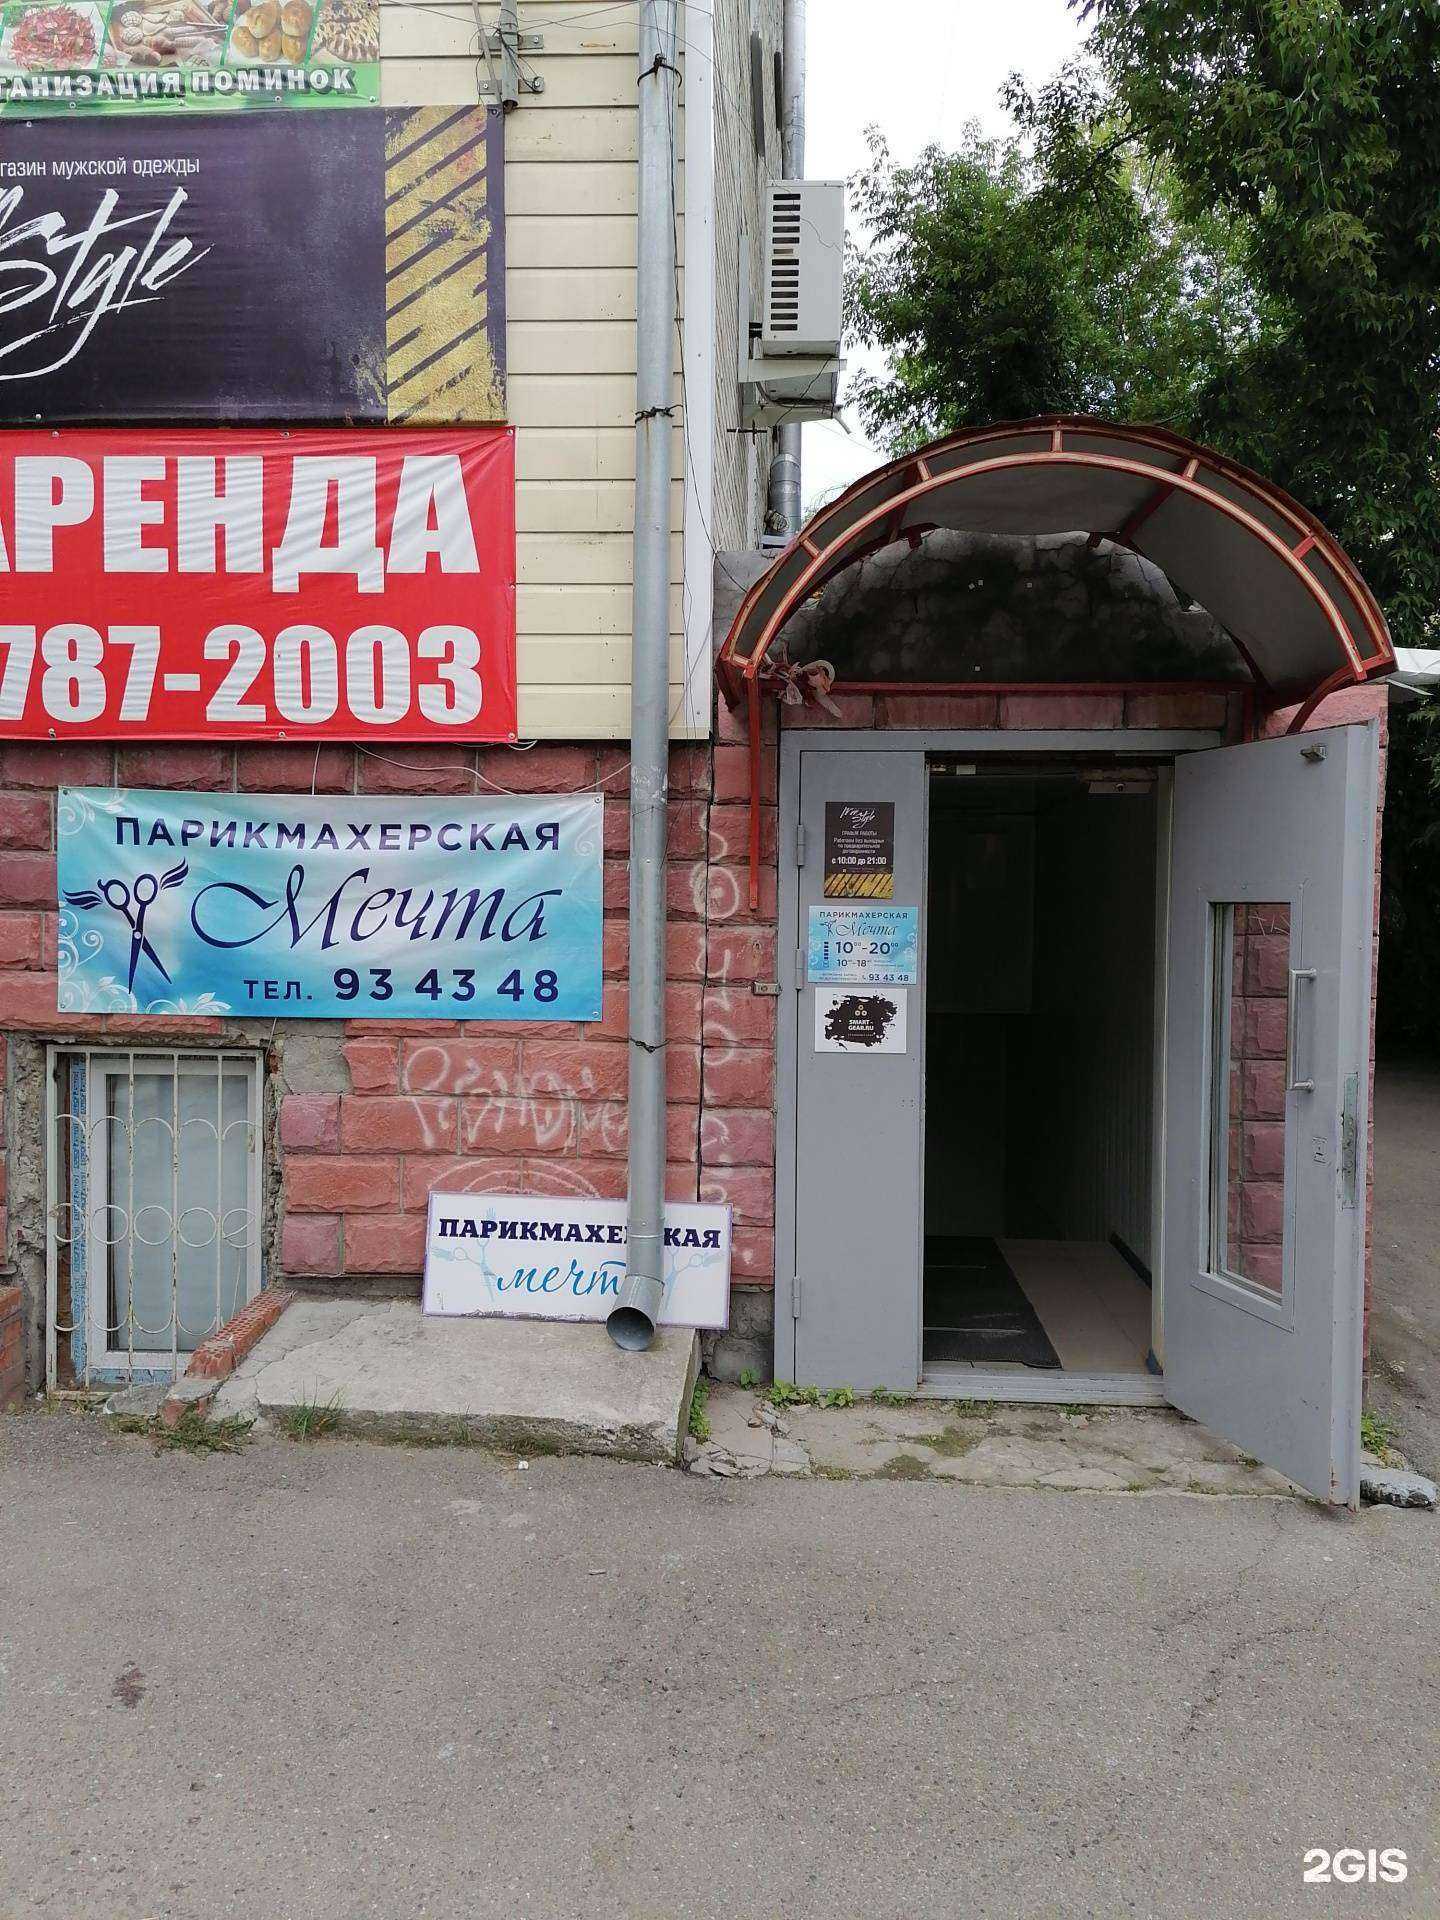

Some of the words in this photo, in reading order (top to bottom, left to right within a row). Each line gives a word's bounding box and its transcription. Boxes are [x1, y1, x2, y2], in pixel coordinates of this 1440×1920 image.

[191, 68, 353, 92] ПОМИНОК
[0, 161, 47, 177] газин
[53, 157, 127, 180] мужской
[132, 158, 200, 178] одежды
[0, 455, 481, 594] РЕНДА
[115, 816, 561, 852] ПАРИКМАХЕРСКАЯ
[837, 856, 857, 865] 10:00
[867, 856, 887, 865] 21:00
[191, 864, 563, 951] Мечта
[819, 911, 908, 919] ПАРИКМАХЕРСКАЯ
[835, 921, 900, 936] Мечта
[243, 979, 313, 1001] ТЕЛ.
[333, 967, 394, 1001] 93
[415, 968, 477, 1002] 43
[497, 969, 559, 1003] 48
[868, 973, 880, 982] 93
[883, 973, 895, 982] 43
[897, 973, 909, 982] 48
[438, 1218, 721, 1248] ПАРИКМАХЕКАЯ
